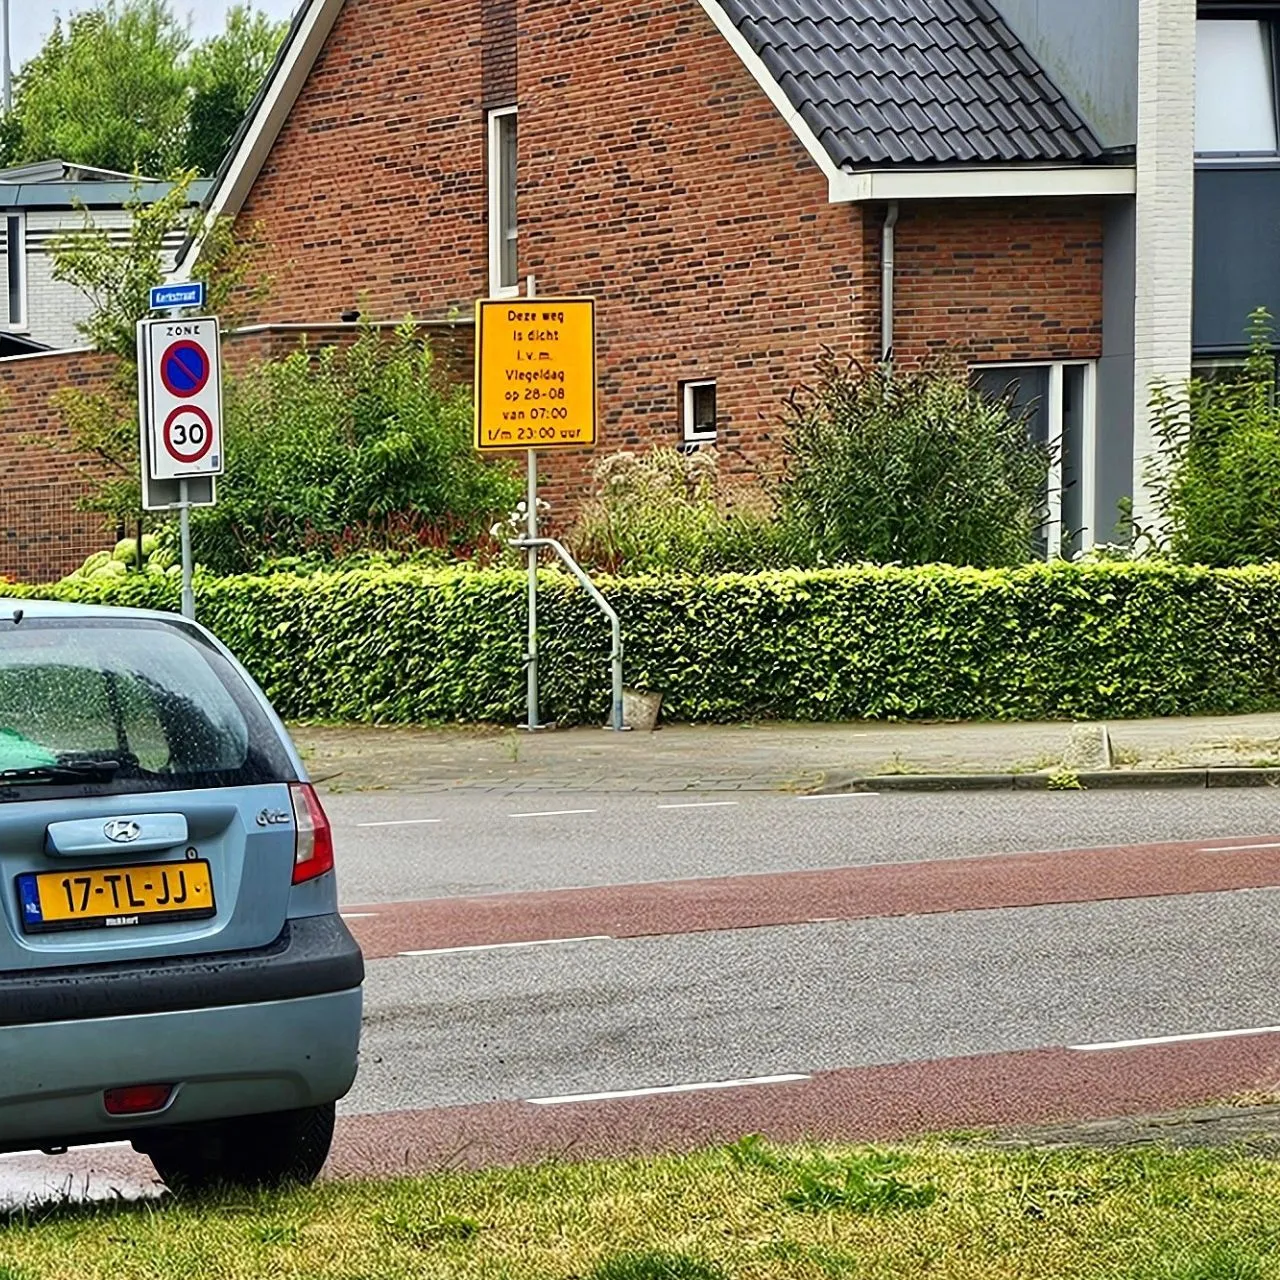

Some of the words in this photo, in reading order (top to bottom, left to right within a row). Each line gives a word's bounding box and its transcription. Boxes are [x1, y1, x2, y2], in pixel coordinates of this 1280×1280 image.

[507, 310, 537, 322] Deze
[542, 311, 565, 324] weg
[166, 325, 201, 336] ZONE
[527, 330, 559, 341] dicht
[505, 369, 565, 383] Vlegeldag
[504, 391, 519, 401] op
[524, 387, 565, 400] 28-08
[502, 411, 525, 420] van
[530, 407, 568, 419] 07:00
[173, 423, 204, 446] 30
[488, 427, 512, 440] t/m
[517, 426, 555, 440] 23:00
[560, 429, 581, 438] uur
[61, 870, 188, 913] 17-TL-JJ
